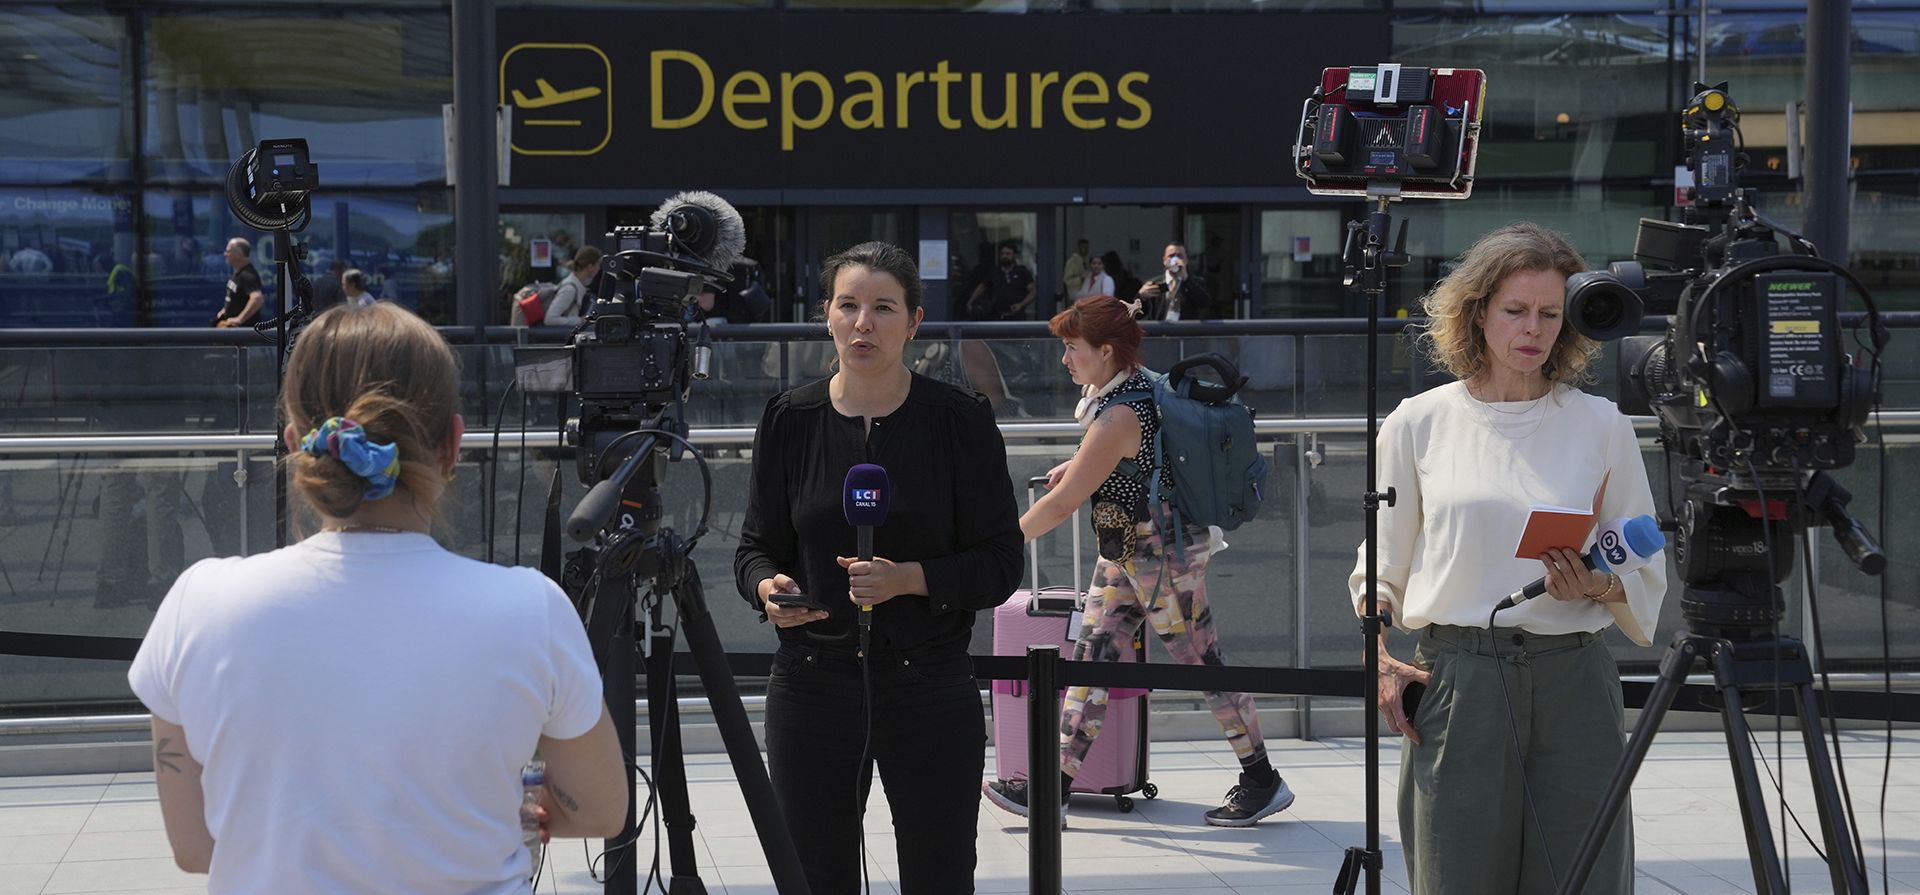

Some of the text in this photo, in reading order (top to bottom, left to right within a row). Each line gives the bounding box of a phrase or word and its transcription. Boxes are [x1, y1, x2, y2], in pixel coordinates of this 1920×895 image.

[650, 49, 1153, 151] Departures
[14, 196, 79, 213] Change
[1768, 283, 1812, 291] NEEWER
[856, 491, 877, 500] LCI
